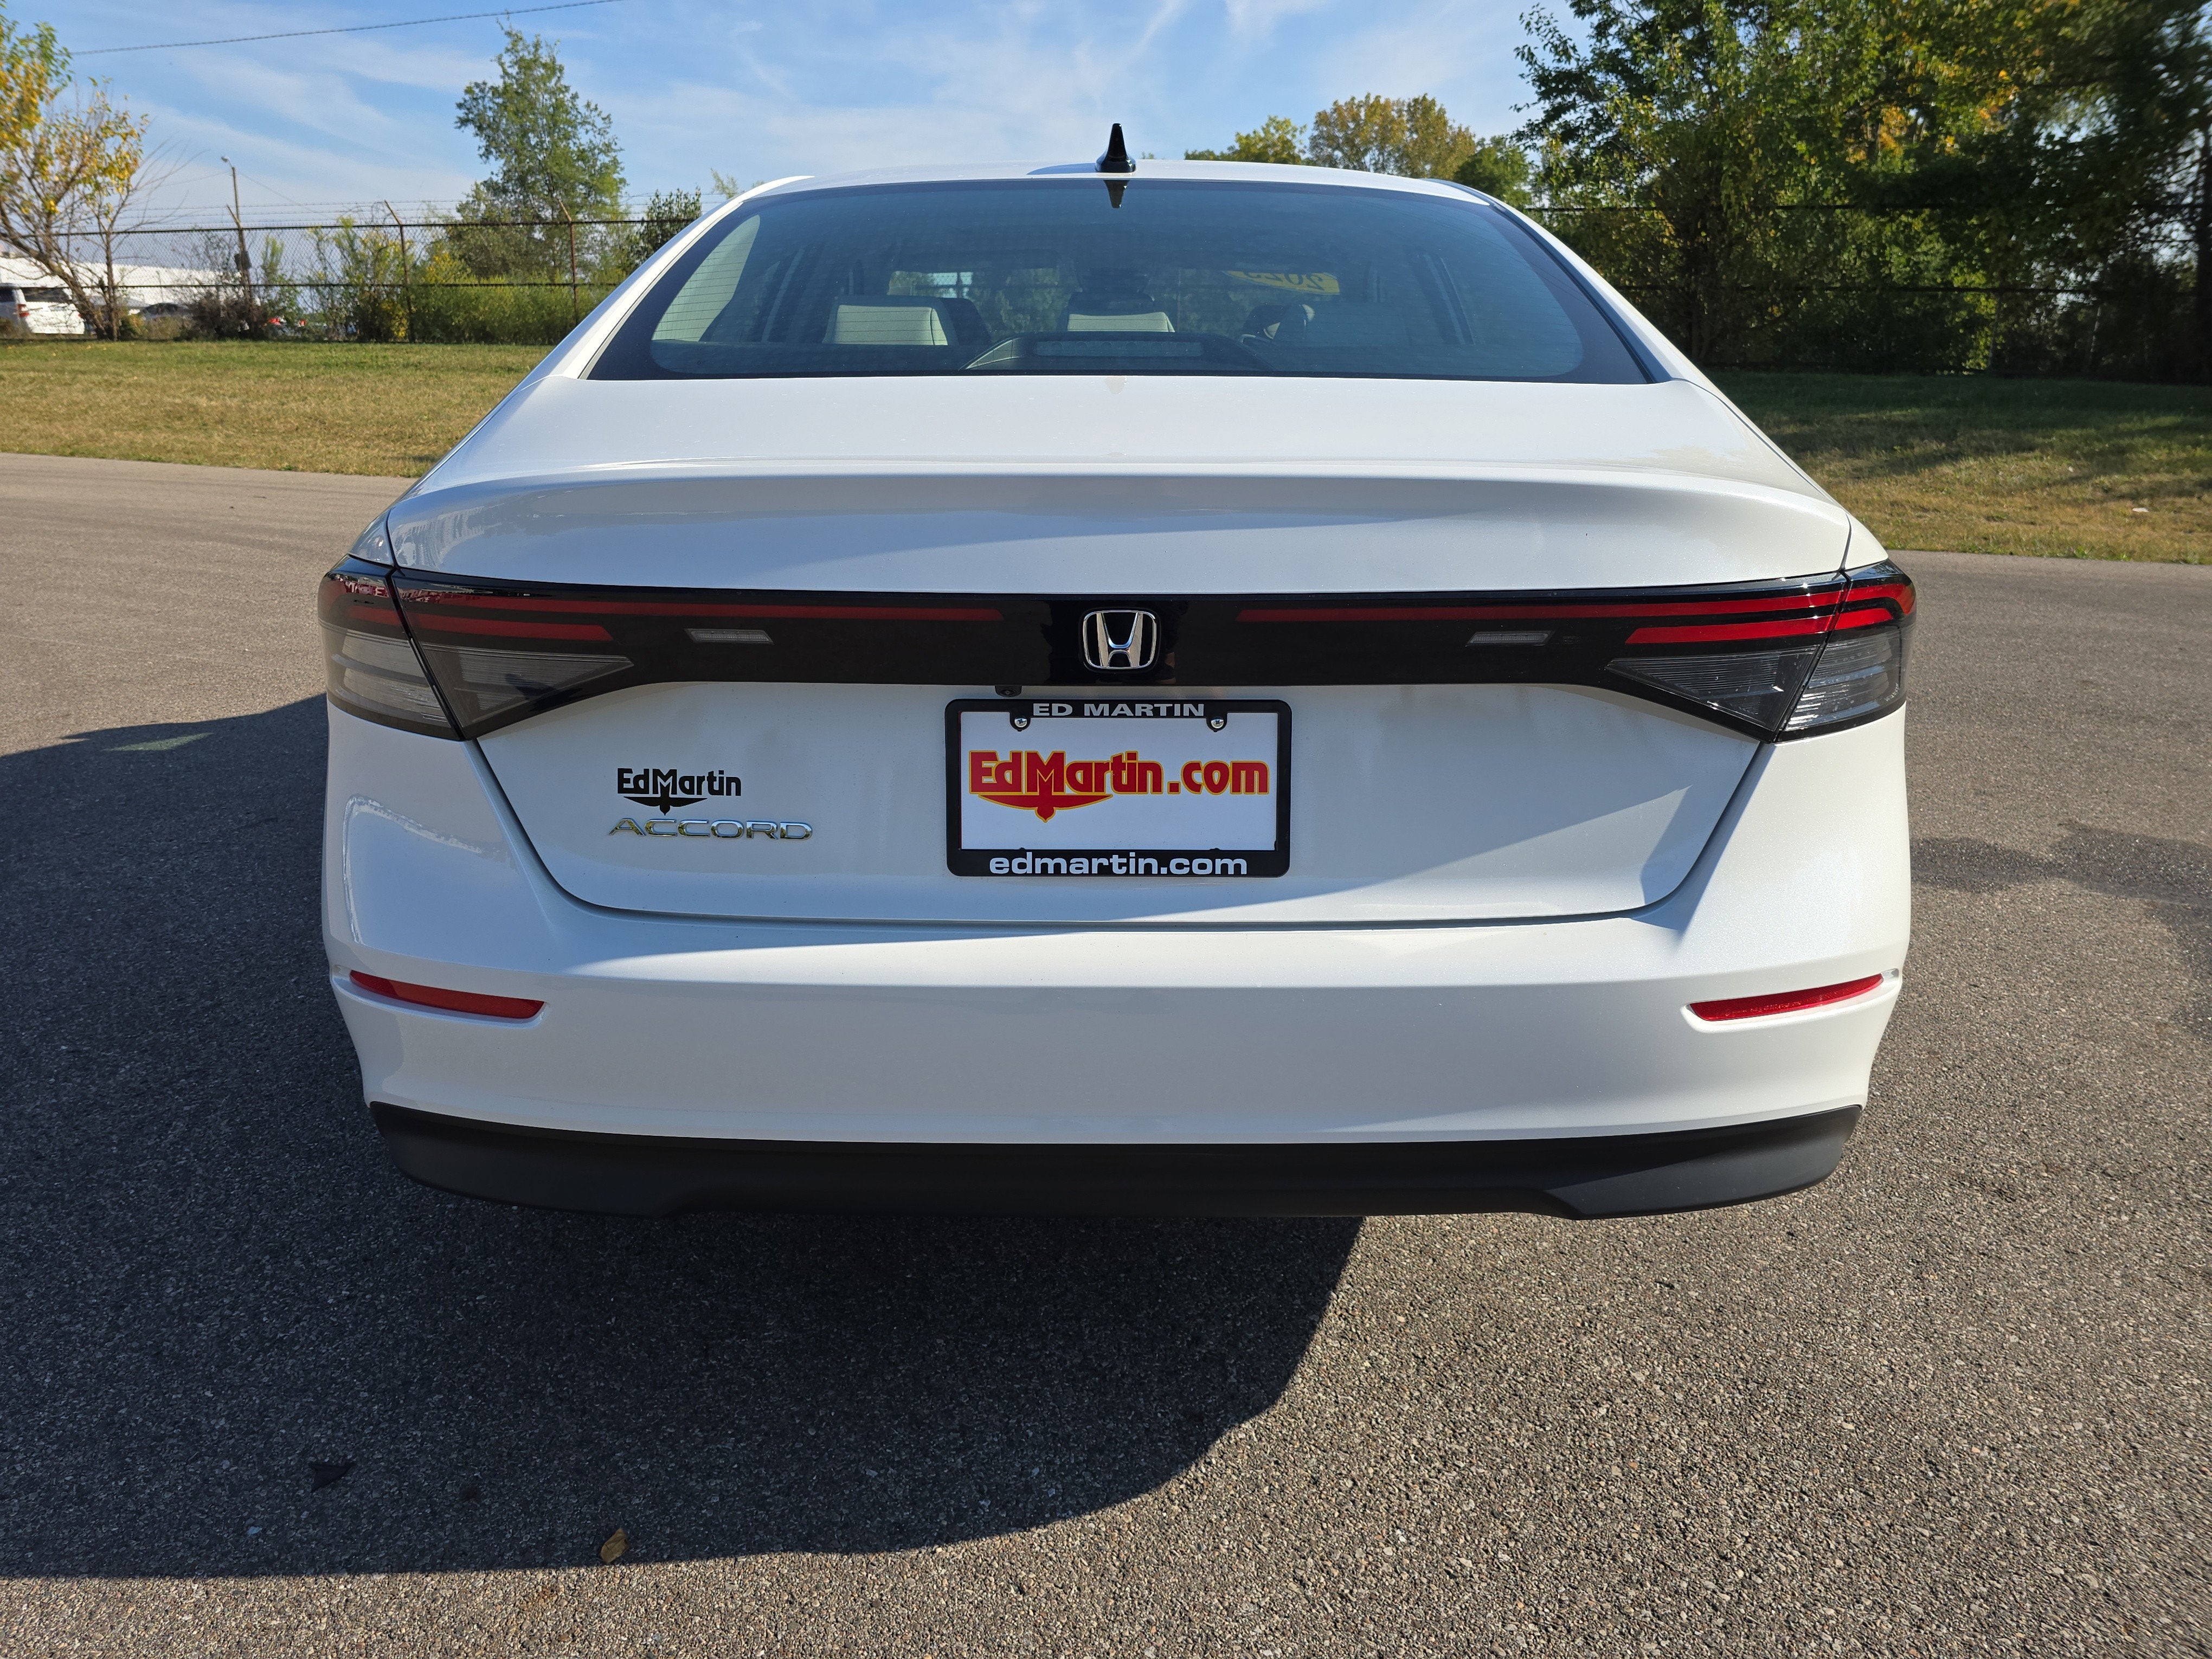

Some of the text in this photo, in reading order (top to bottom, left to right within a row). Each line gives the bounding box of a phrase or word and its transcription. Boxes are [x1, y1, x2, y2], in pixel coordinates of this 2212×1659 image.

[1033, 703, 1204, 717] ED MARTIN
[617, 768, 742, 796] EdMartin
[968, 750, 1270, 795] EdMartin.com
[608, 818, 813, 840] ACCORD
[989, 851, 1247, 875] edmartin.com
